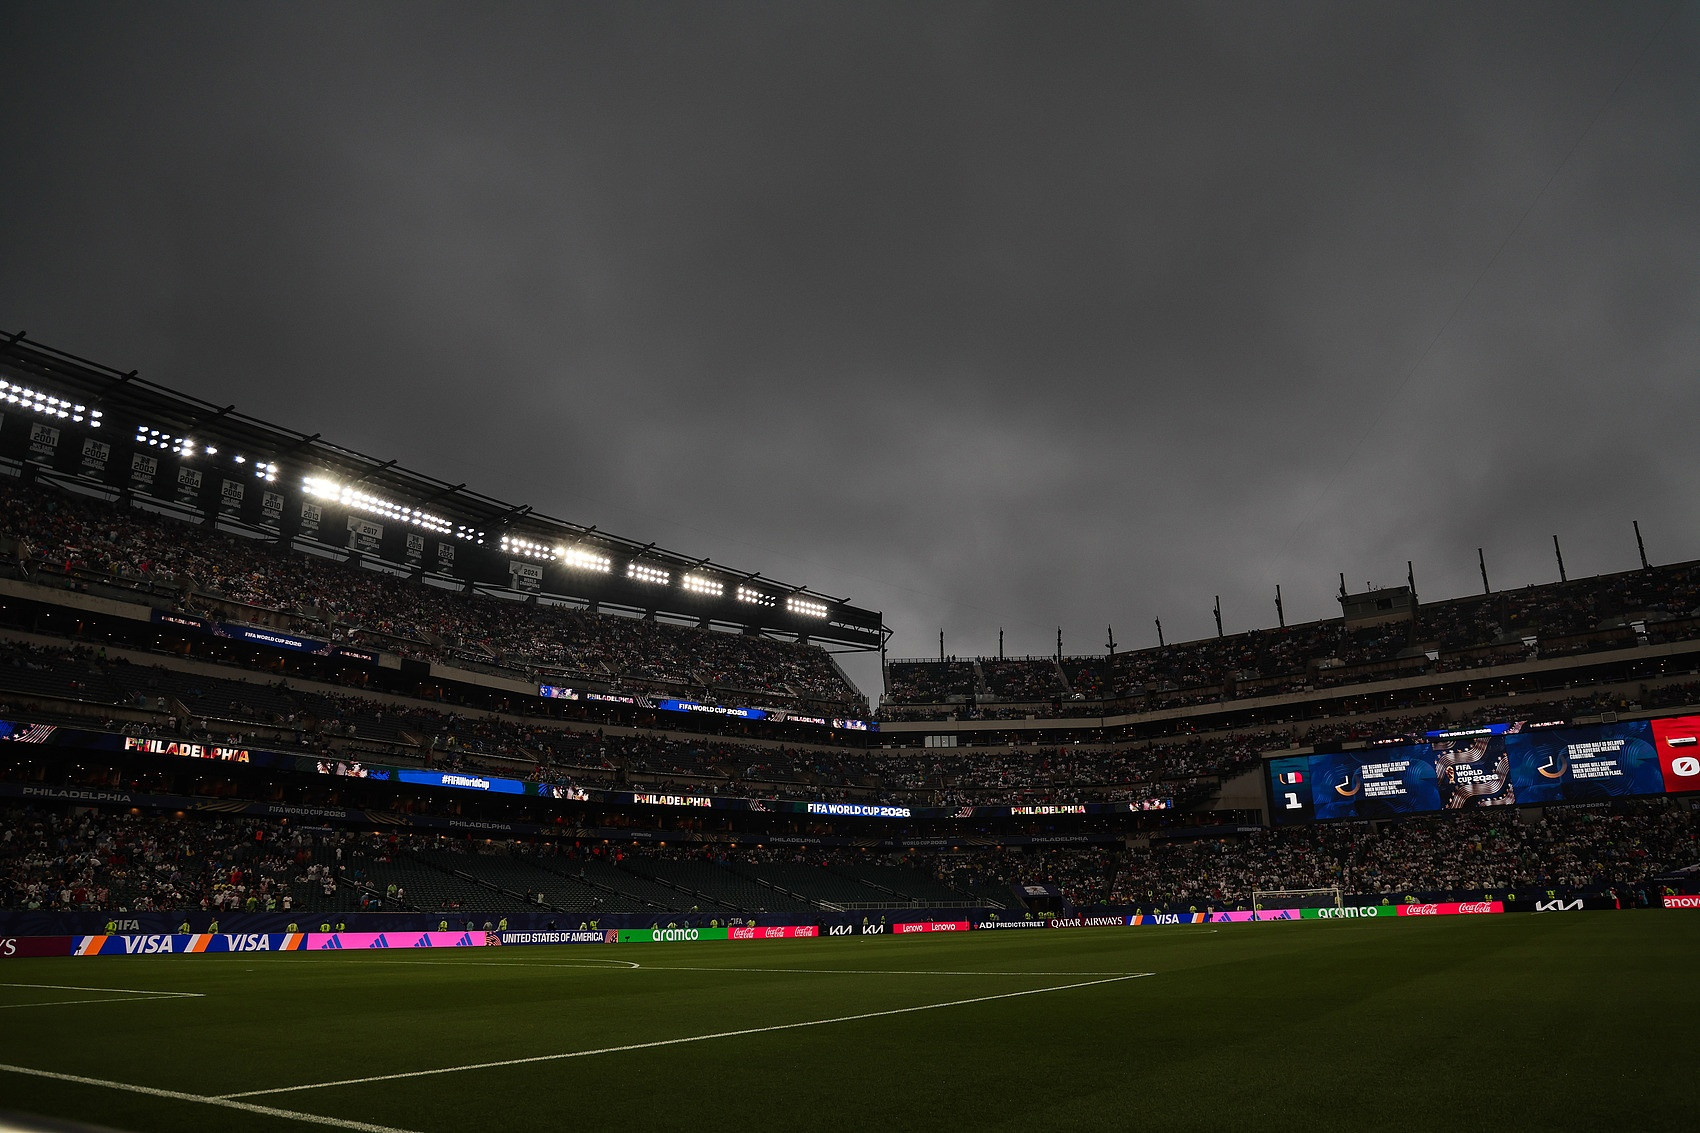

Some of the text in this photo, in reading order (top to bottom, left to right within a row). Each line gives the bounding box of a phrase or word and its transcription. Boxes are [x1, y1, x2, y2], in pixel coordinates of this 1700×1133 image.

[34, 432, 55, 444] 2001
[84, 448, 106, 459] 2002
[134, 462, 154, 473] 2003
[180, 475, 199, 486] 2004
[265, 500, 280, 509] 2010
[304, 511, 319, 520] 2013
[364, 526, 378, 536] 2017
[257, 634, 274, 642] WORLD
[587, 693, 634, 704] PHILADELPHIA
[679, 703, 691, 712] FIFA
[692, 704, 712, 714] WORLD
[713, 706, 727, 715] CUP
[787, 716, 825, 725] PHILADELPHIA
[124, 736, 250, 764] PHILADELPHIA
[1672, 756, 1700, 776] 0
[1456, 769, 1483, 777] WORLD
[1473, 774, 1498, 782] 2026
[442, 775, 489, 790] #FIFAWorldCup
[22, 786, 131, 802] PHILADELPHIA
[634, 794, 712, 808] PHILADELPHIA
[1284, 792, 1302, 810] 1
[807, 803, 910, 817] FIFA WORLD CUP 2026
[1011, 804, 1086, 815] PHILADELPHIA
[450, 820, 512, 830] PHILADELPHIA
[1459, 902, 1491, 914] Coca-Cola
[1535, 899, 1584, 912] KIA
[1664, 898, 1700, 907] enov
[1318, 907, 1377, 918] aramco
[1406, 904, 1437, 915] Coca-Cola
[1051, 916, 1123, 929] QATAR AIRWAYS
[1153, 914, 1179, 924] VISA
[734, 927, 754, 938] Coca-Cola
[765, 927, 785, 938] Coca-Cola
[794, 926, 813, 936] Coca-Cola
[829, 925, 852, 936] KIA
[862, 924, 884, 935] KIA
[902, 924, 923, 932] Lenovo
[931, 922, 955, 932] Lenovo
[502, 931, 604, 944] UNITED STATES OF AMERICA
[653, 928, 698, 941] aramco
[120, 935, 173, 954] VISA
[224, 934, 270, 952] VISA
